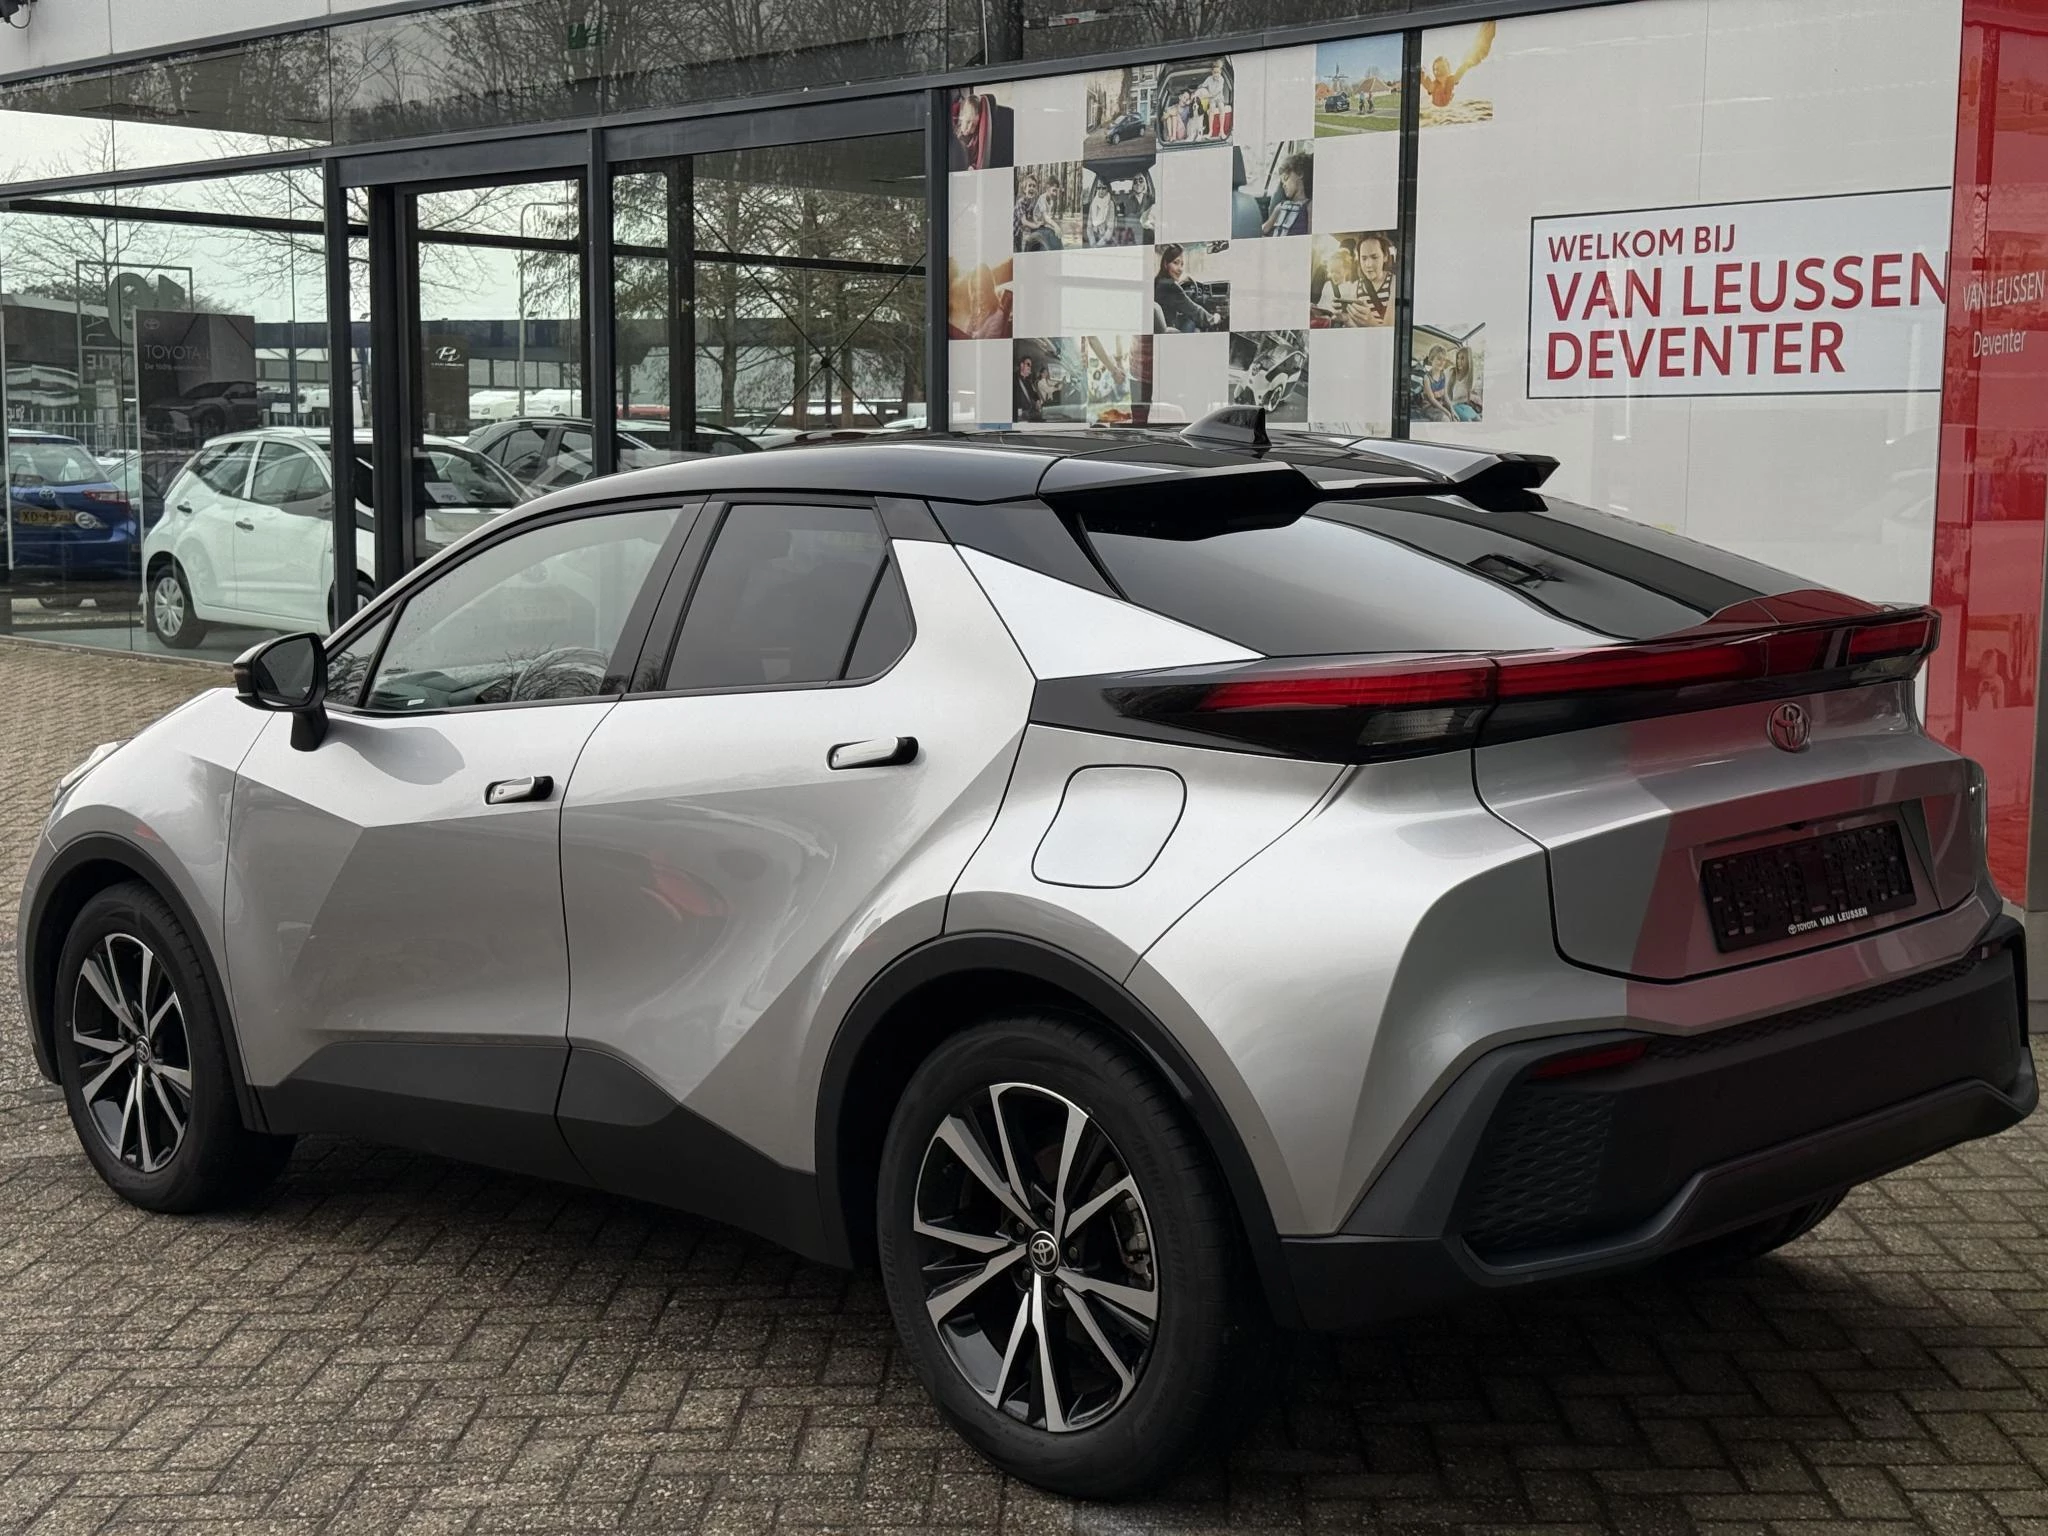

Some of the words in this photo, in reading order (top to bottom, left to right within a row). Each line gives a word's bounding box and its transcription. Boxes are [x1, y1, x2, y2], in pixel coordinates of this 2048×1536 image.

[1548, 228, 1684, 263] WELKOM
[1694, 224, 1736, 255] BIJ
[1547, 267, 1662, 321] VAN
[1682, 251, 1948, 317] LEUSSEN
[1963, 281, 1987, 311] VAN
[1990, 271, 2046, 307] LEUSSEN
[144, 344, 201, 360] TOYOTA
[1547, 321, 1846, 381] DEVENTER
[1972, 328, 2027, 358] Deventer
[1796, 920, 1818, 932] TOYOTA
[1820, 914, 1835, 927] VAN
[1837, 906, 1868, 922] LEUSSEN
